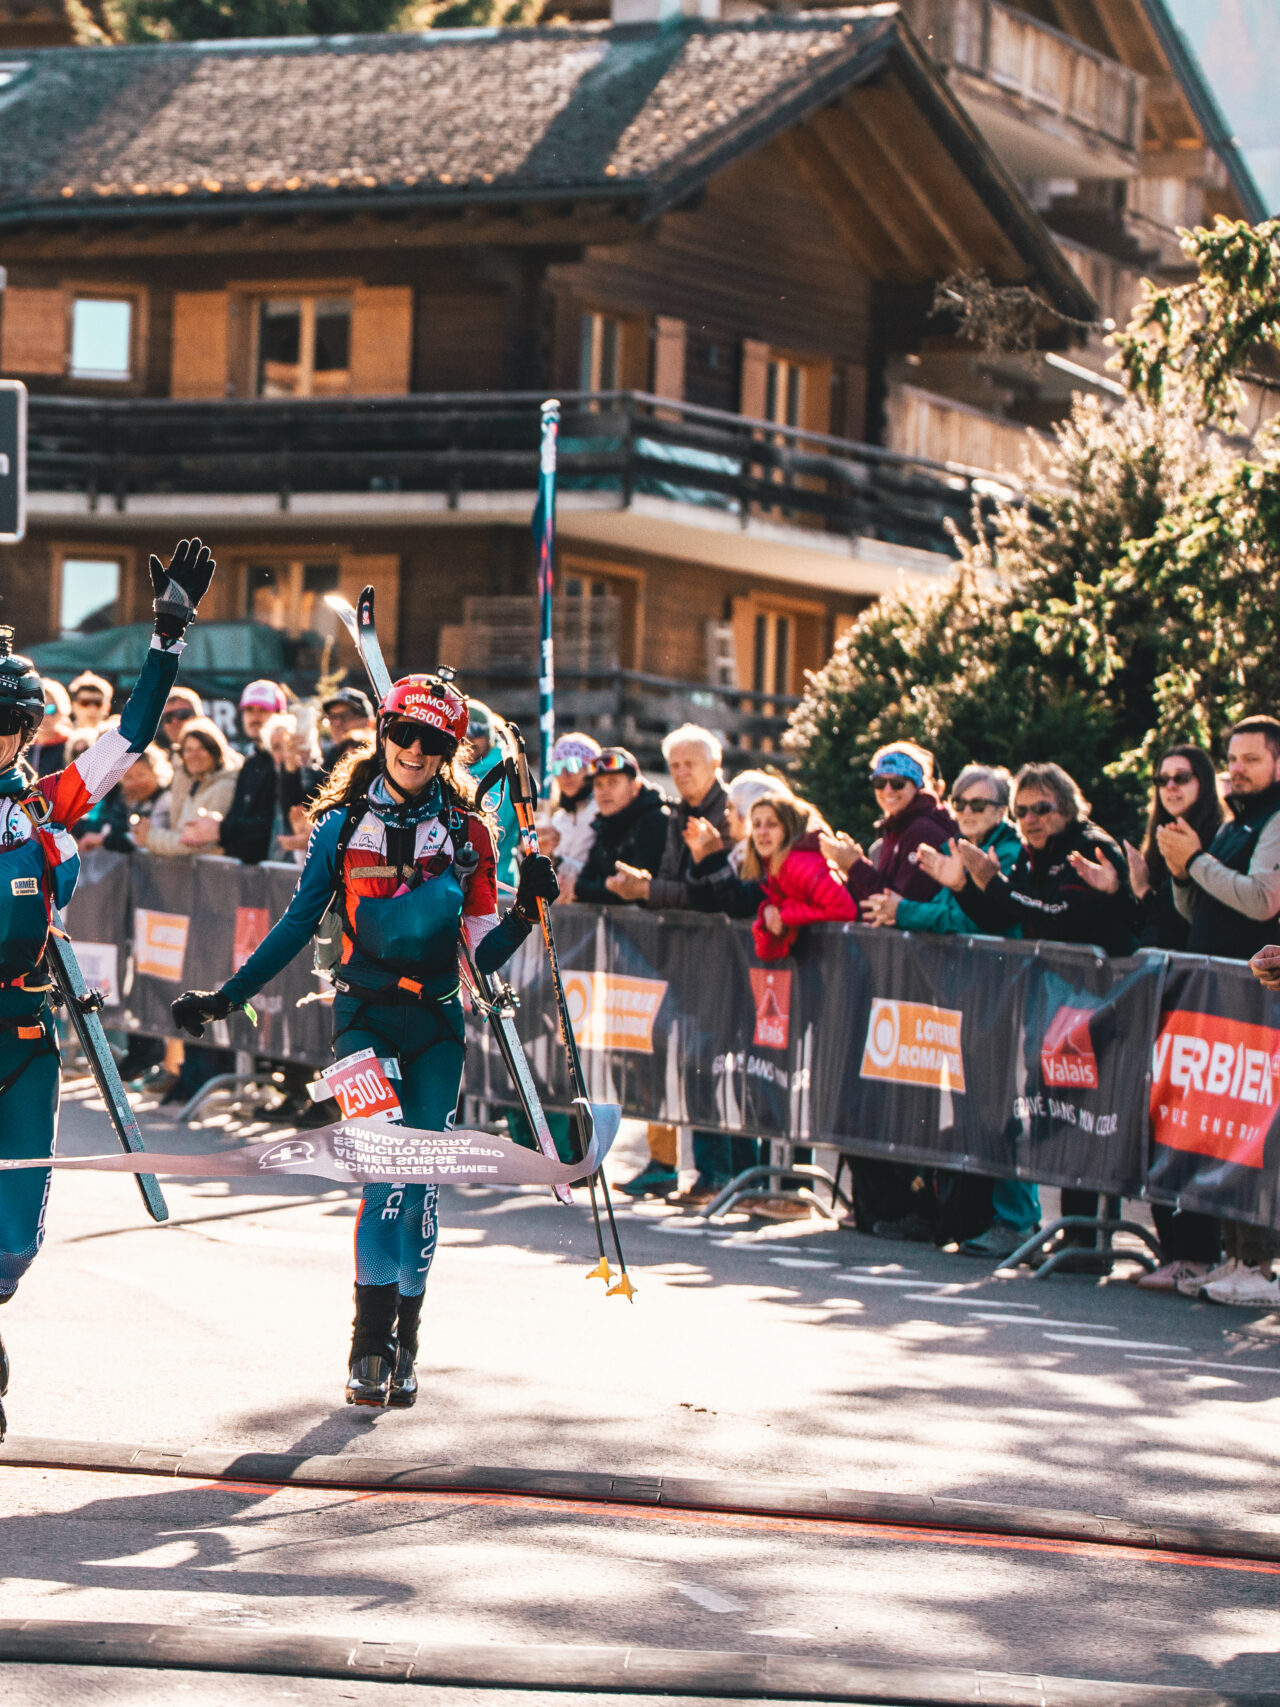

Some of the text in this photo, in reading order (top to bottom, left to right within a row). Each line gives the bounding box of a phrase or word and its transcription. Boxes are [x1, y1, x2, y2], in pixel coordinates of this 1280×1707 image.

[405, 693, 459, 723] CHAMONIX
[410, 706, 443, 728] 2500
[1042, 1056, 1095, 1084] Valais
[1048, 1097, 1077, 1125] DANS
